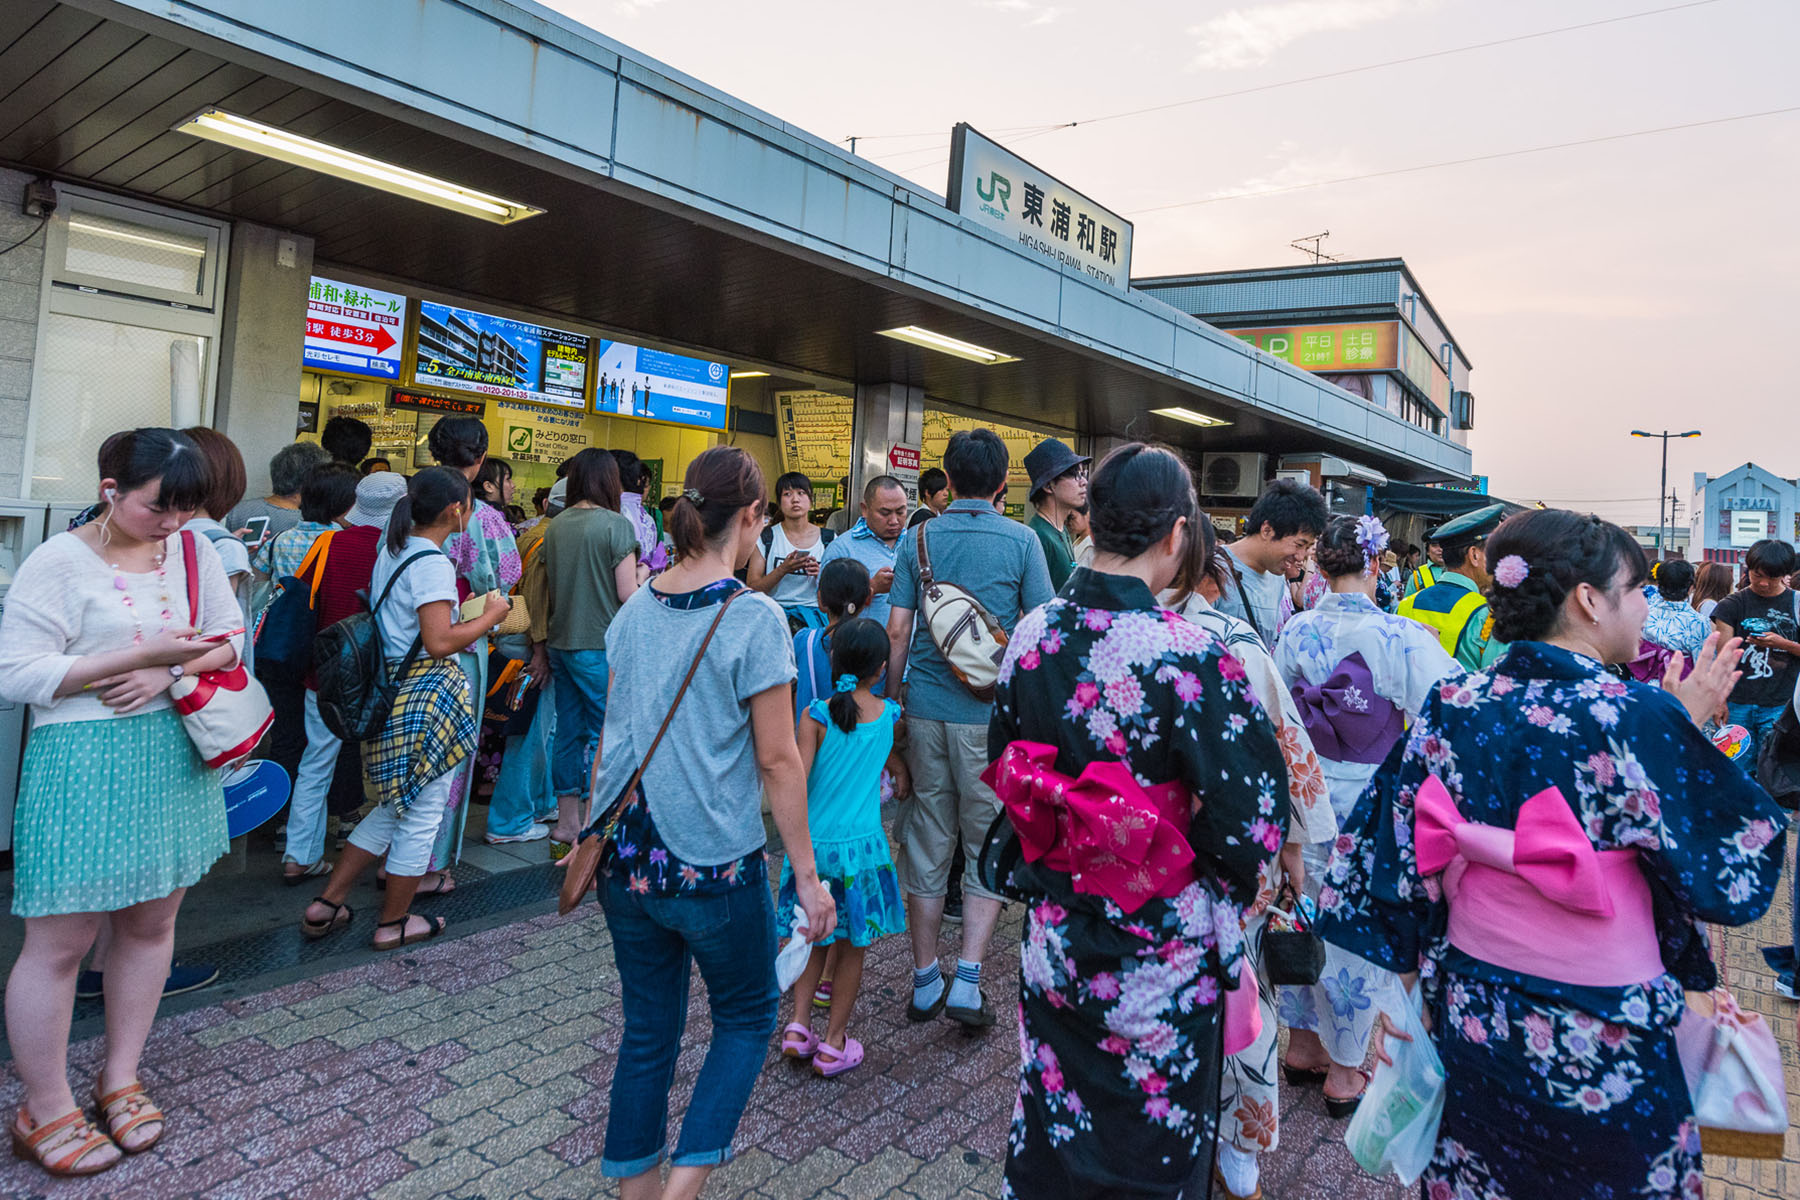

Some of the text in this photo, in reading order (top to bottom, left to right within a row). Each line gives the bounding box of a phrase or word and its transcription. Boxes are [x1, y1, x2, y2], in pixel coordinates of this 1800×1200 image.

[976, 171, 1011, 212] JR
[1022, 181, 1117, 265] 東浦和駅
[330, 325, 375, 343] 徒歩3分
[1346, 332, 1372, 346] 土日
[1269, 338, 1288, 355] P
[1305, 335, 1331, 349] 平日
[1345, 347, 1373, 360] 診療
[483, 385, 528, 400] 0120-201-135
[535, 429, 586, 445] みどりの窓口
[552, 442, 568, 450] Office
